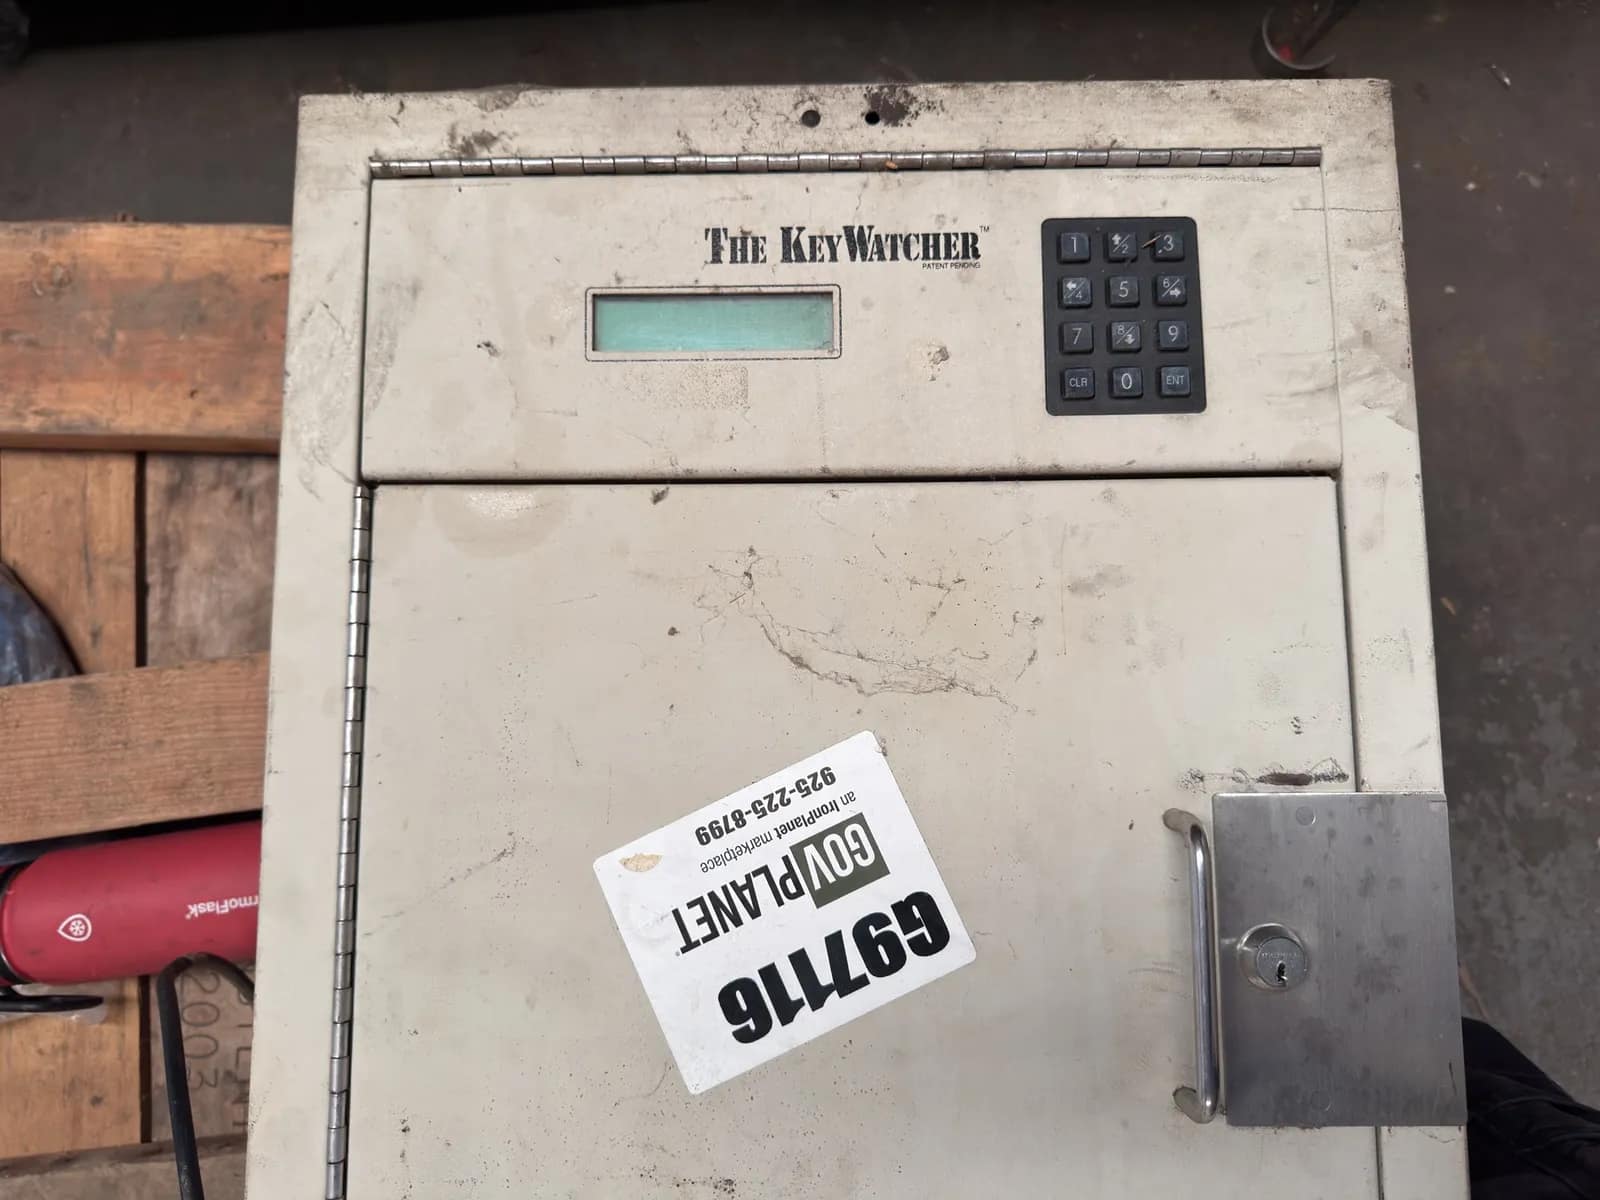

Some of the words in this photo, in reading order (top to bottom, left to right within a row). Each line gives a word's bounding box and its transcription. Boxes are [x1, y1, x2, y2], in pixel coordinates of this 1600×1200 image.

[1070, 236, 1078, 253] 1
[1163, 234, 1175, 251] 3
[922, 262, 948, 270] PATENT
[950, 261, 981, 270] PENDING
[1118, 280, 1129, 298] 5
[1071, 327, 1082, 345] 7
[1168, 325, 1179, 342] 9
[1069, 376, 1088, 387] CLR
[1121, 373, 1133, 390] 0
[1166, 375, 1185, 385] ENT
[694, 765, 837, 847] 925-225-8799
[839, 790, 856, 806] an
[772, 798, 841, 841] IronPlanet
[699, 831, 773, 874] marketplace
[187, 895, 259, 918] rmoFlask
[717, 890, 951, 1045] G97116
